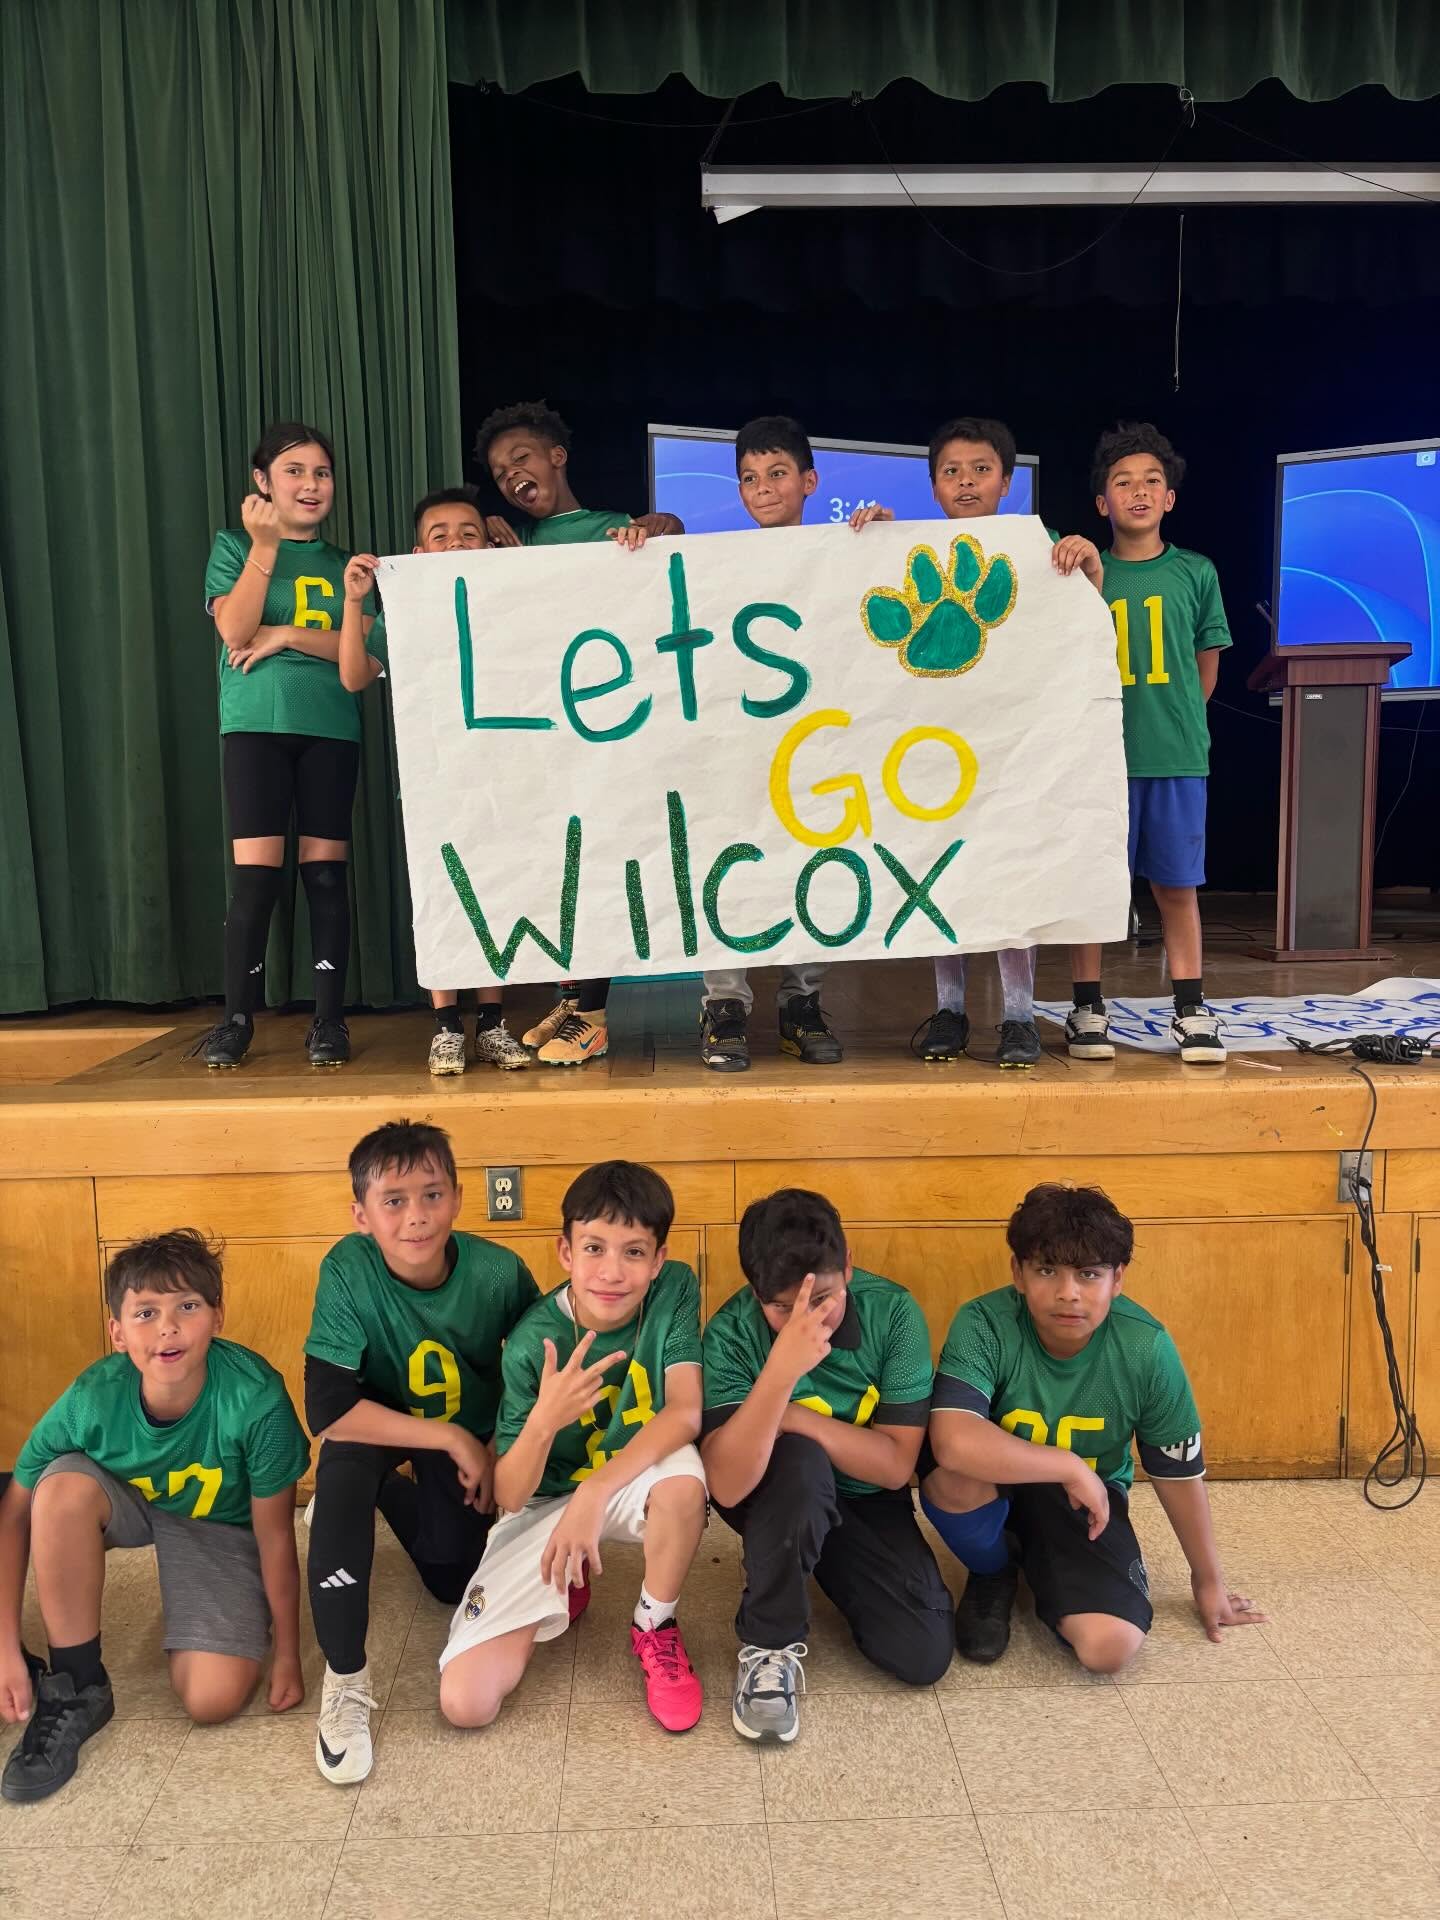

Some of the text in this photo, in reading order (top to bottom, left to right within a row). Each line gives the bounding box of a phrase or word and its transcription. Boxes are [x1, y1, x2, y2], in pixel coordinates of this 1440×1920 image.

[294, 575, 335, 630] 6
[455, 552, 811, 743] Lets
[1109, 595, 1170, 686] 11
[441, 790, 966, 985] Wilcox
[408, 1339, 461, 1423] 9
